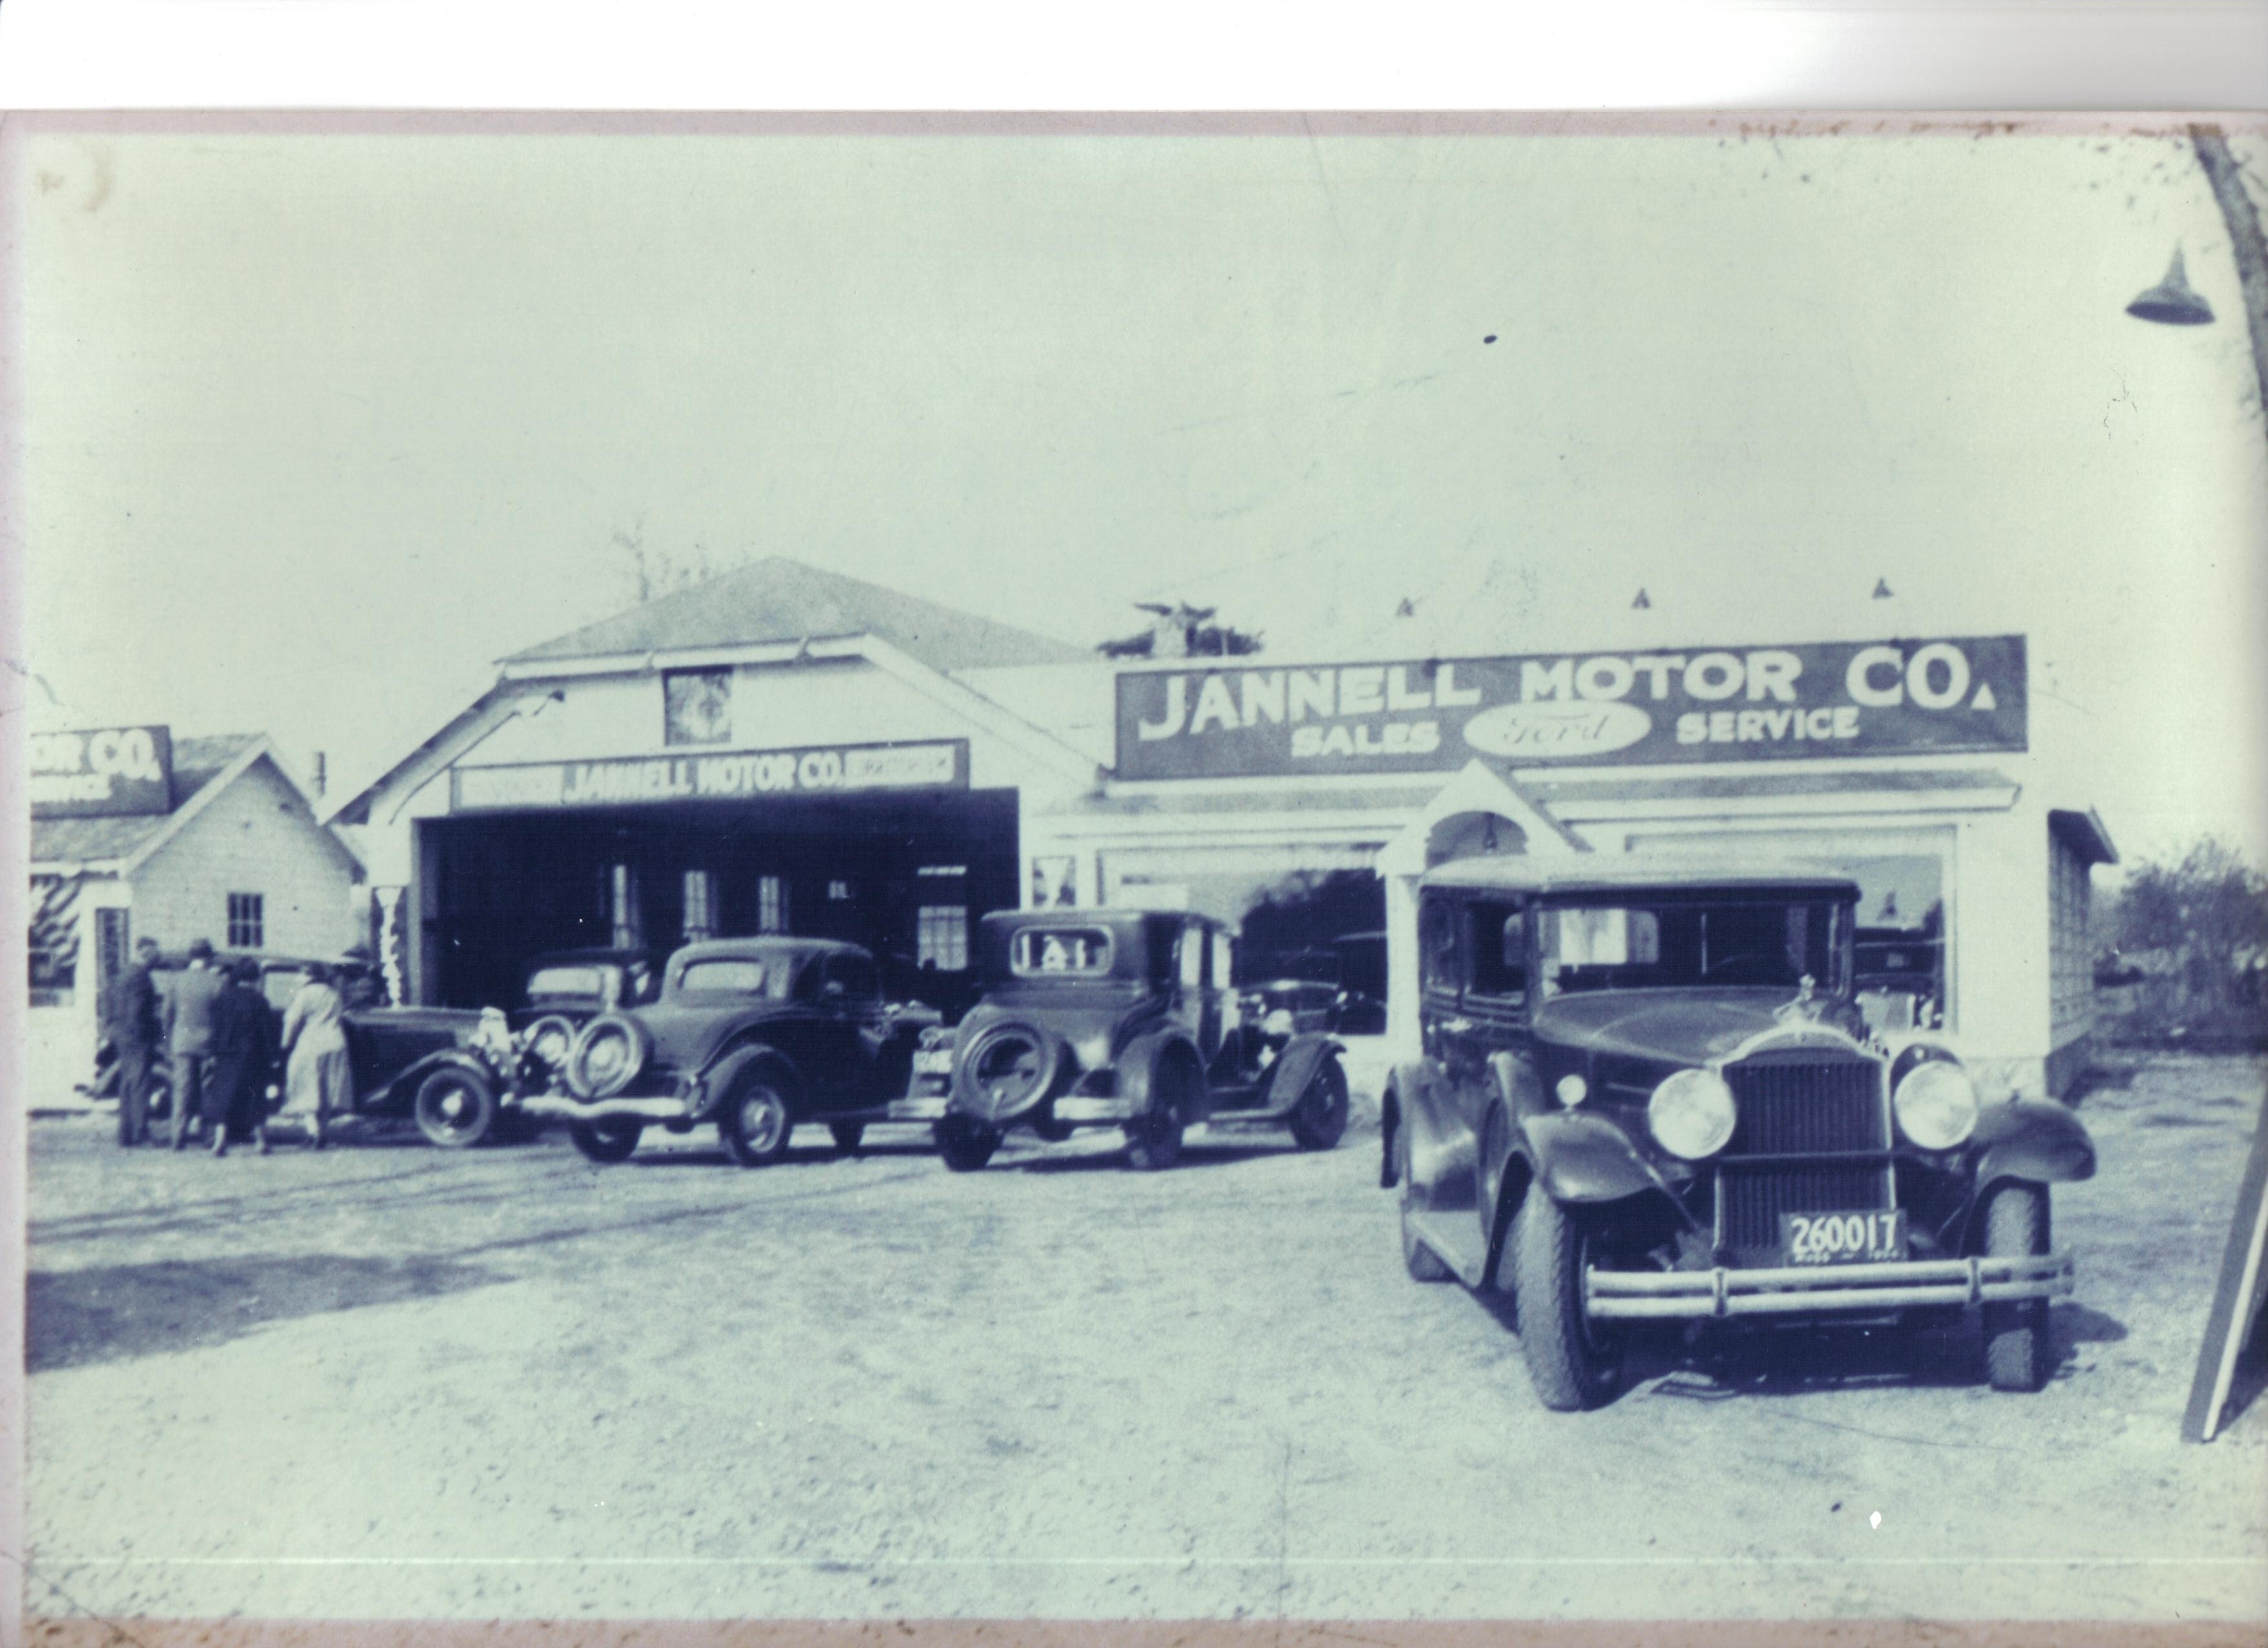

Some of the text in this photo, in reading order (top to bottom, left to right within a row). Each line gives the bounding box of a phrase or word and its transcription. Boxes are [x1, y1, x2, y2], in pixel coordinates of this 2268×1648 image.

[1139, 644, 1995, 740] JANNELL MOTOR CO.
[1294, 708, 1860, 756] SALES Ford SERVICE
[698, 754, 795, 794] MOTOR
[1791, 1214, 1897, 1253] 260017
